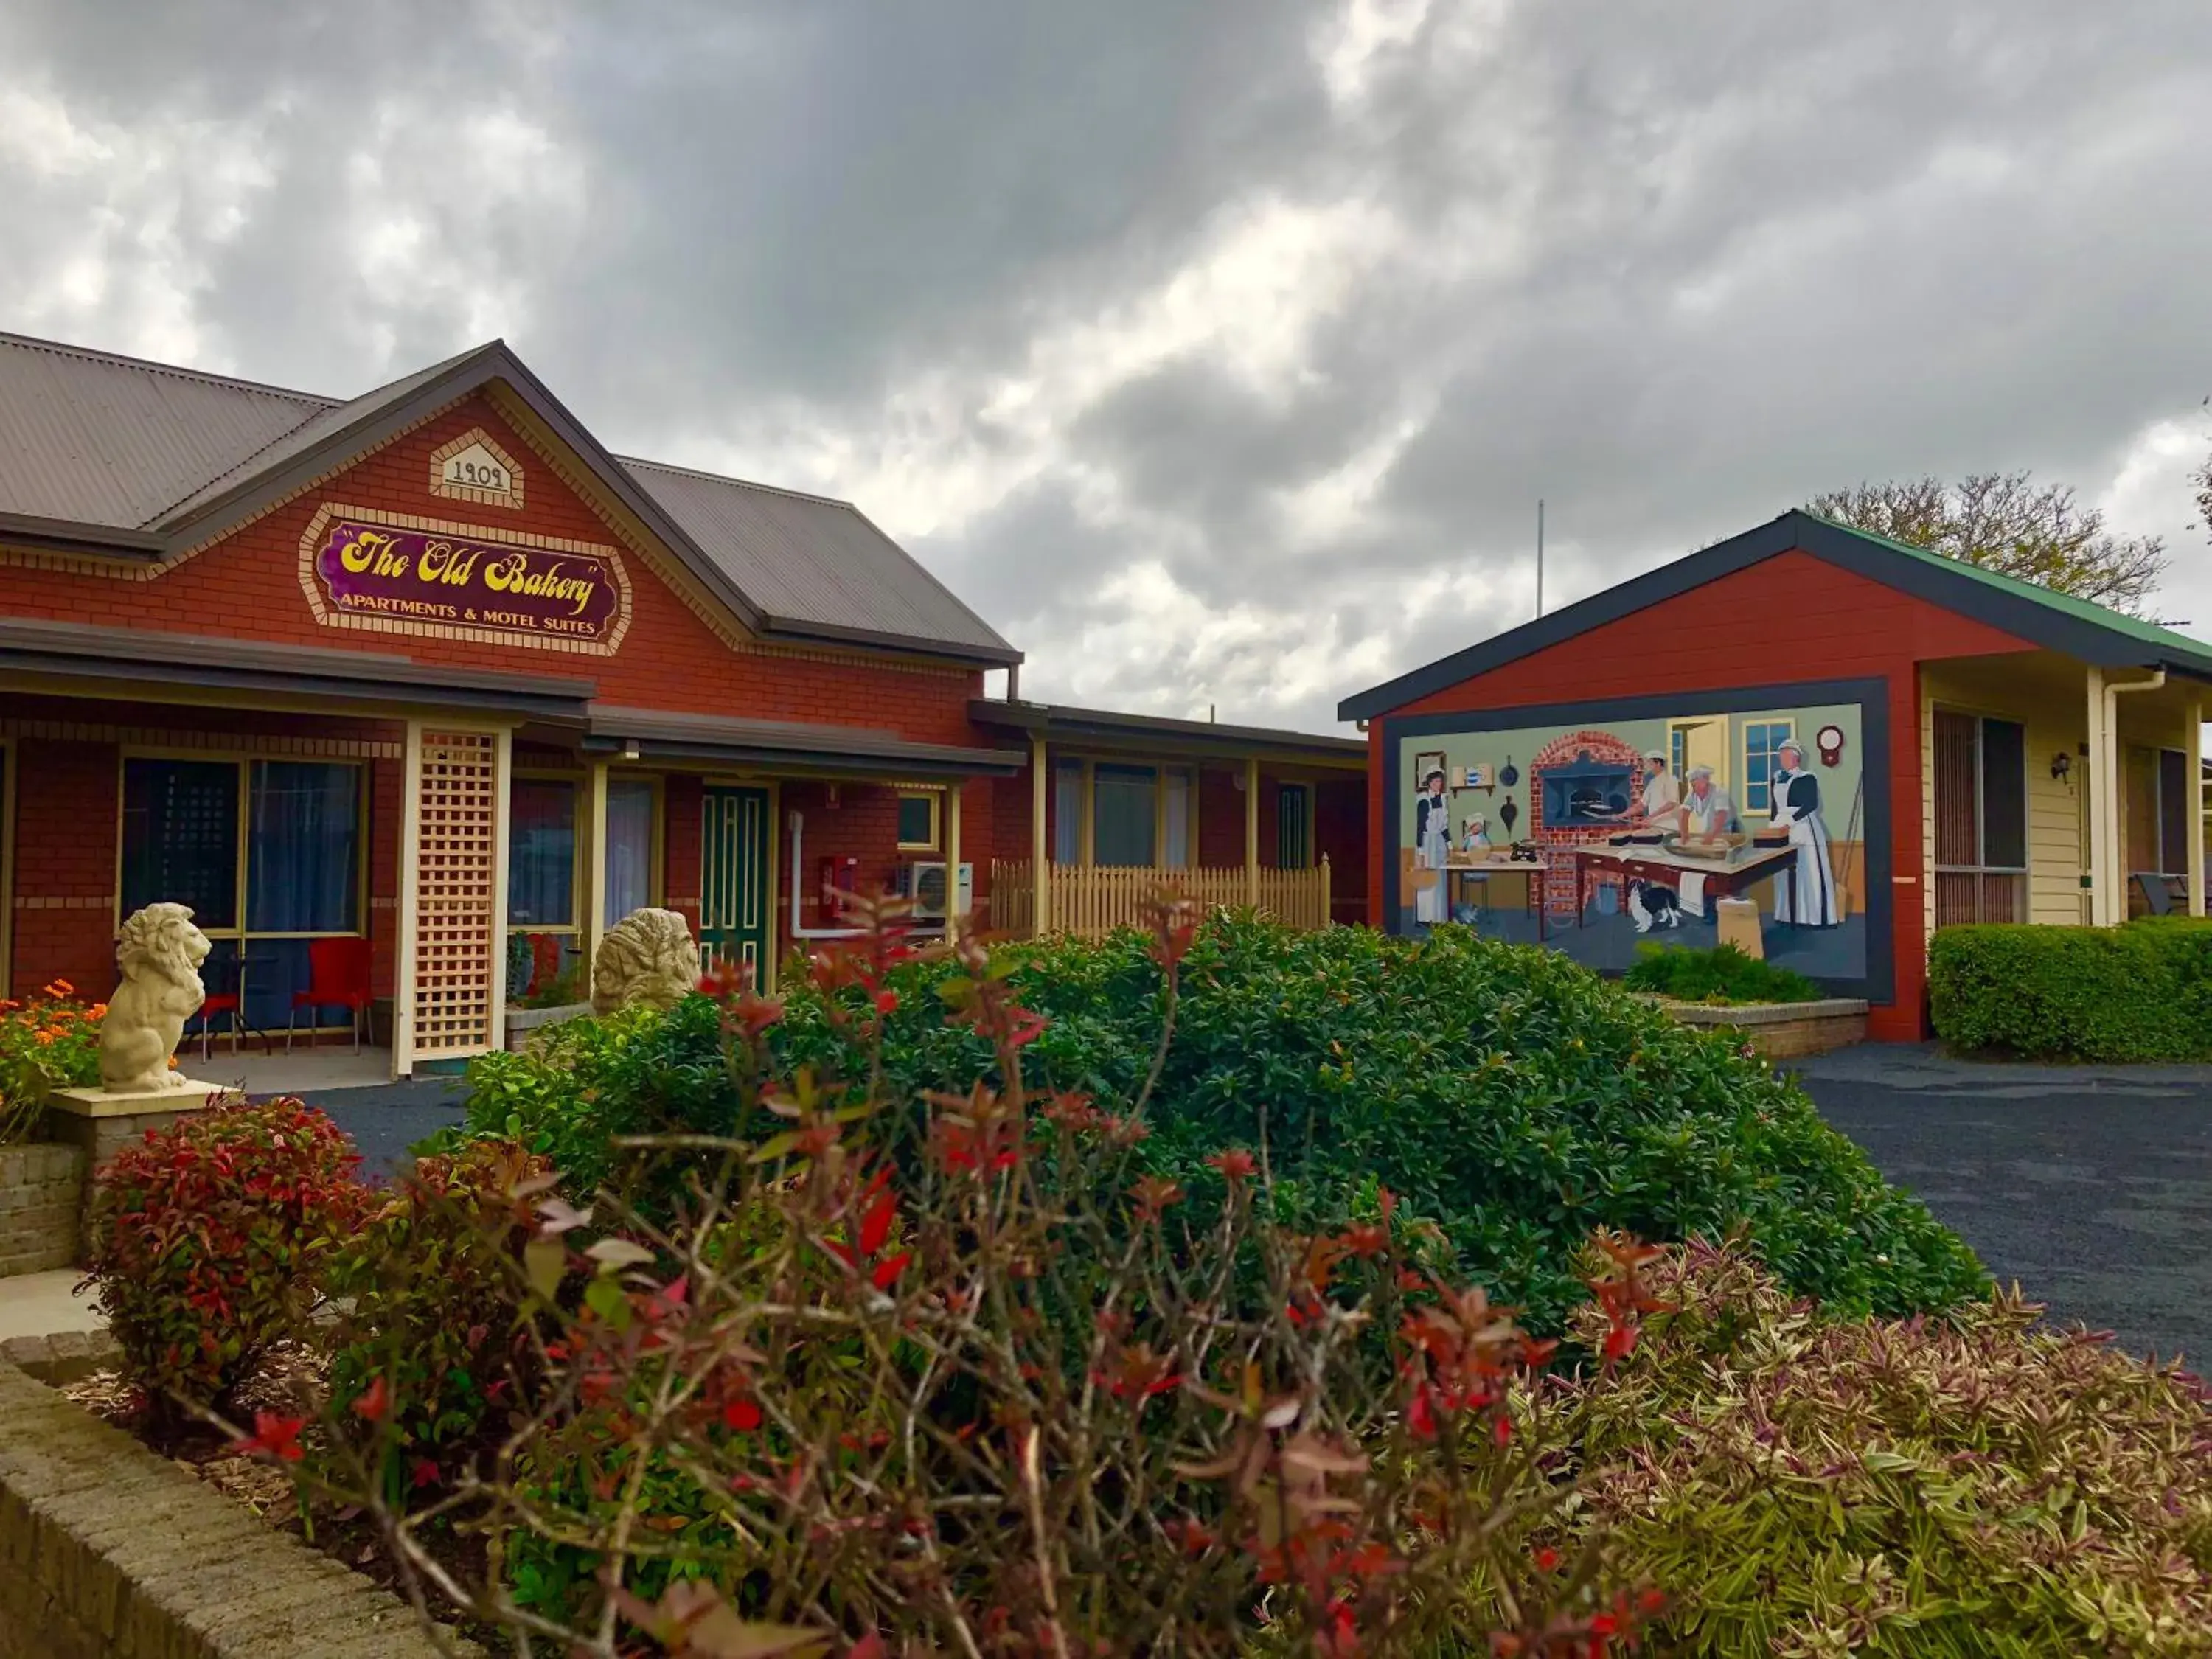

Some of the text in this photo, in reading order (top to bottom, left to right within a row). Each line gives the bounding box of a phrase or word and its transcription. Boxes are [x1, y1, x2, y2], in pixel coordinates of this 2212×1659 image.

[453, 461, 503, 487] 1909
[418, 540, 486, 586] Old
[341, 593, 596, 634] APARTMENTS & MOTEL SUITES
